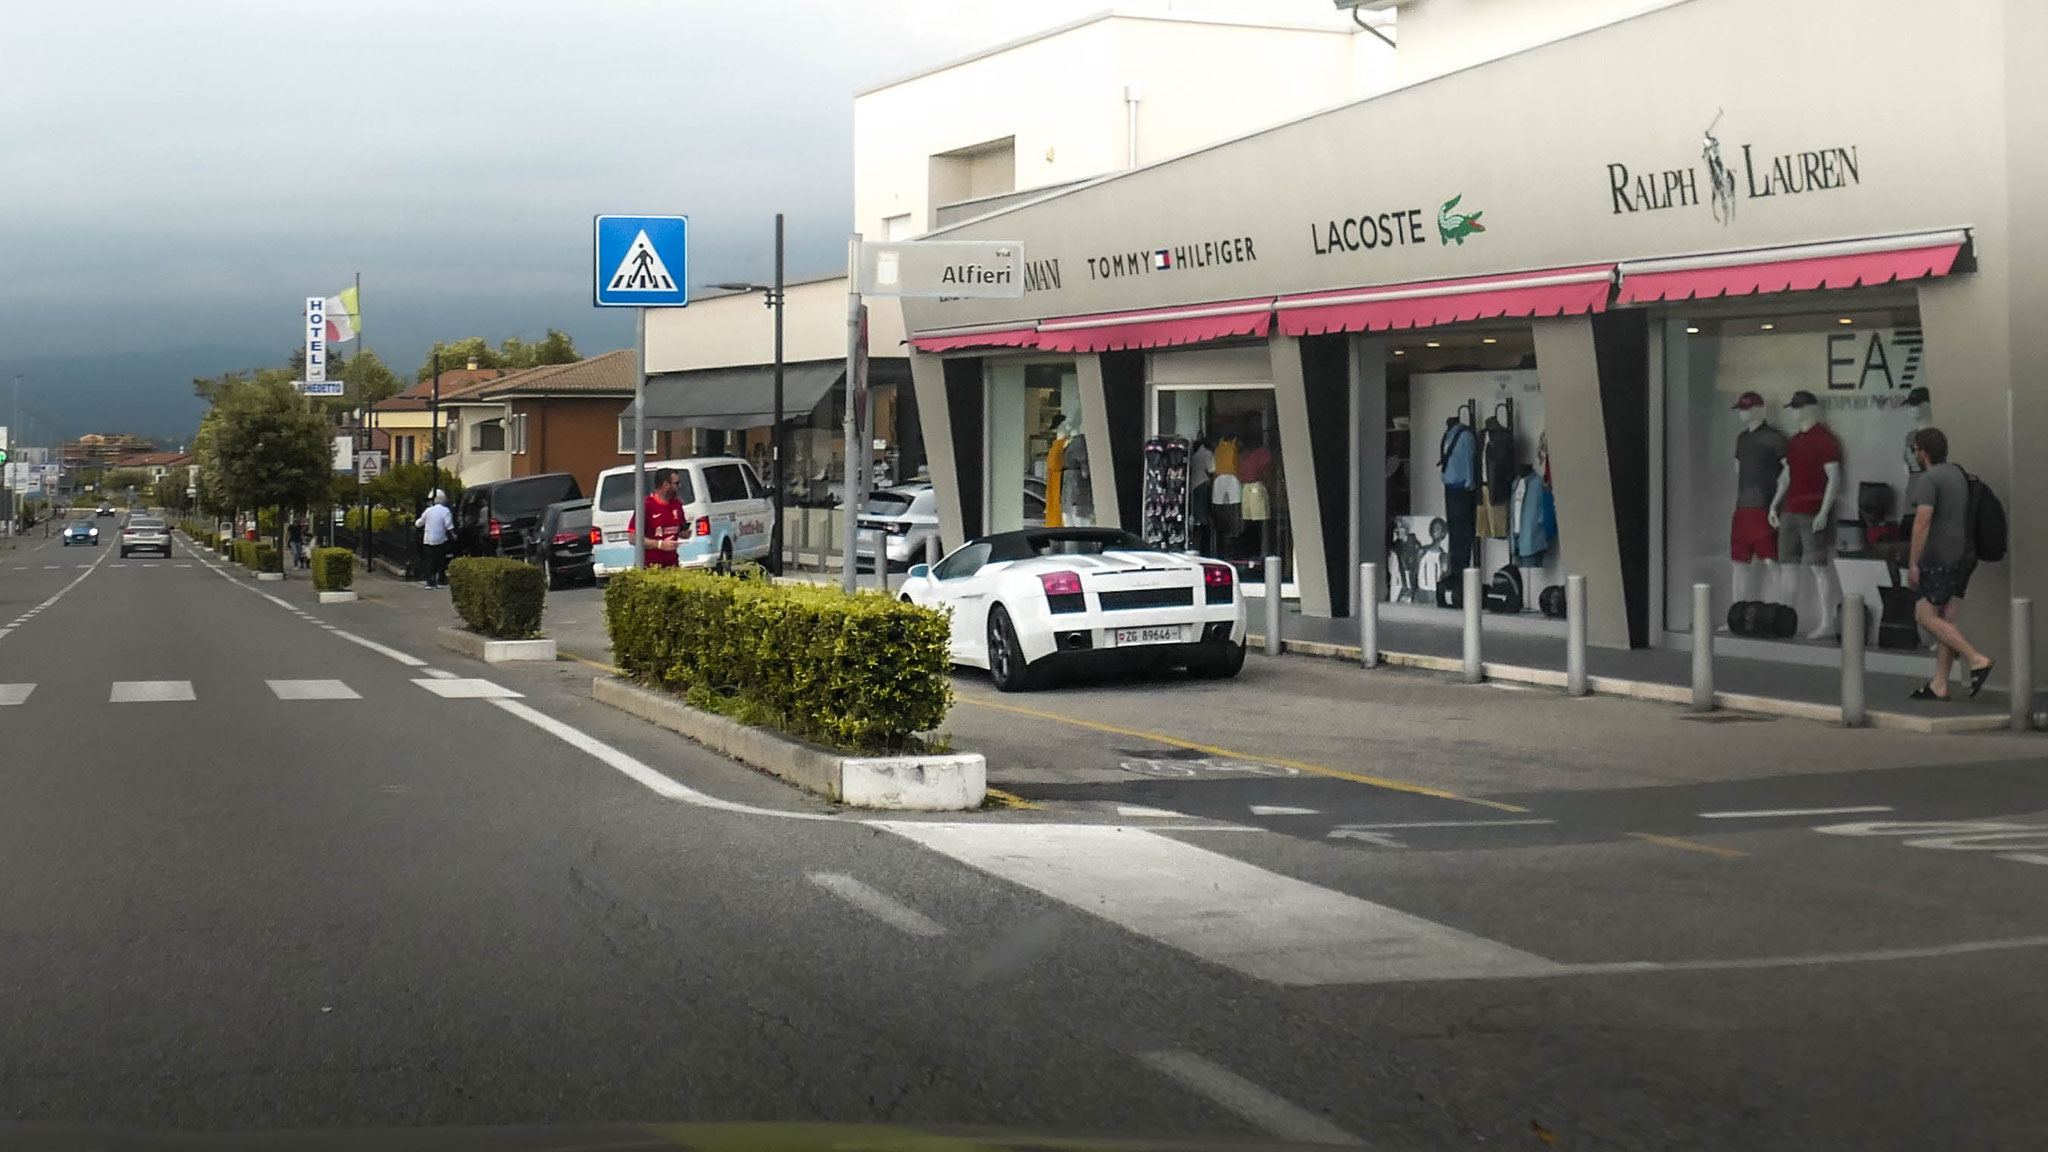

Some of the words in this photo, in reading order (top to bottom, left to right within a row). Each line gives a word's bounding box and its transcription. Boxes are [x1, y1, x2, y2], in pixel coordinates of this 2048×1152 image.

[1606, 162, 1700, 215] RALPH
[1741, 143, 1860, 199] LAUREN
[1311, 208, 1426, 256] LACOSTE
[942, 265, 1011, 284] Alfieri
[1024, 258, 1062, 292] MANI
[1087, 250, 1151, 280] TOMMY
[1174, 236, 1257, 270] HILFIGER
[310, 300, 323, 365] HOTEL
[1827, 329, 1923, 390] EA7
